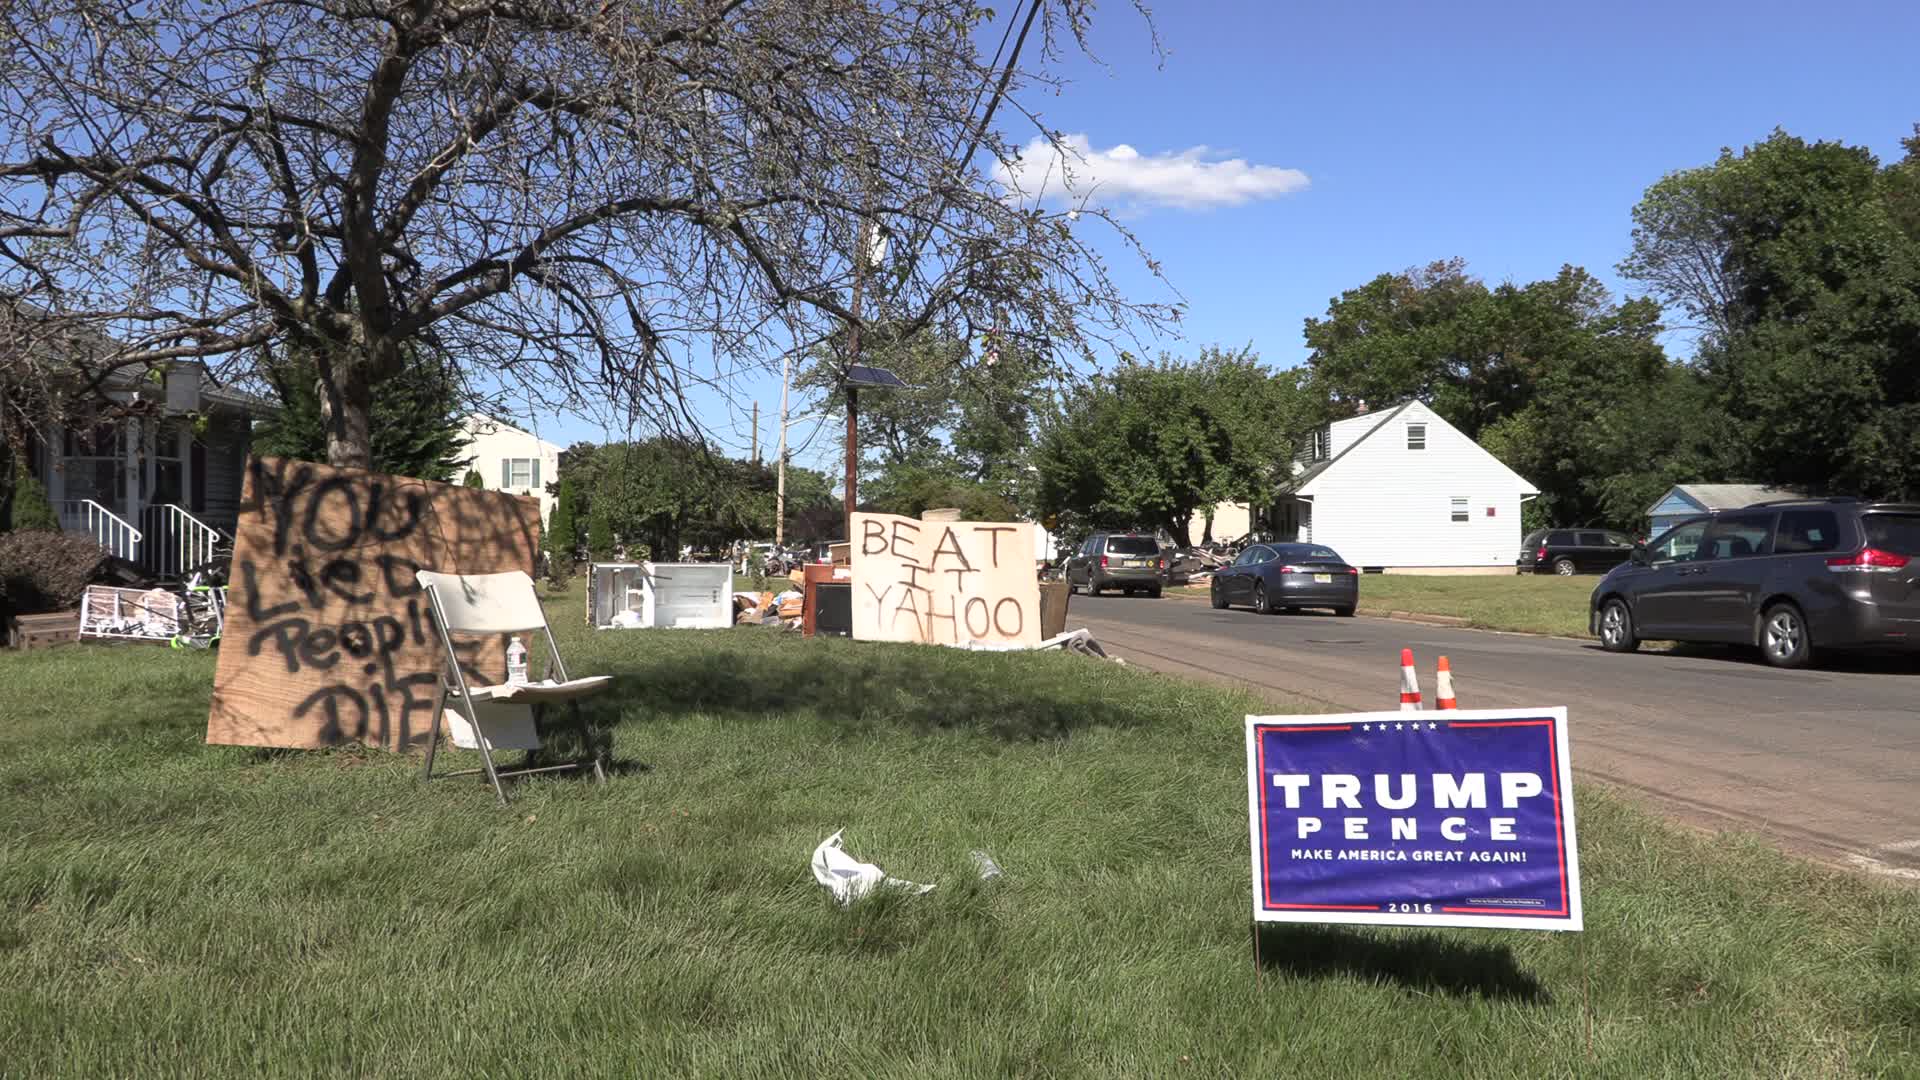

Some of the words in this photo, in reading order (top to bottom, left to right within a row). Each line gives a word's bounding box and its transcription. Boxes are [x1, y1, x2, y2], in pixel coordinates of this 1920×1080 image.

[249, 466, 422, 557] YOU
[863, 520, 1017, 572] BEAT
[898, 563, 981, 593] IT
[865, 583, 1024, 644] YAHOO
[1272, 772, 1543, 810] TRUMP
[1297, 817, 1517, 841] PENCE
[1291, 849, 1333, 860] MAKE
[1337, 850, 1407, 861] AMERICA
[1412, 851, 1464, 862] GREAT
[1469, 851, 1528, 863] AGAIN!
[1388, 903, 1433, 913] 2016
